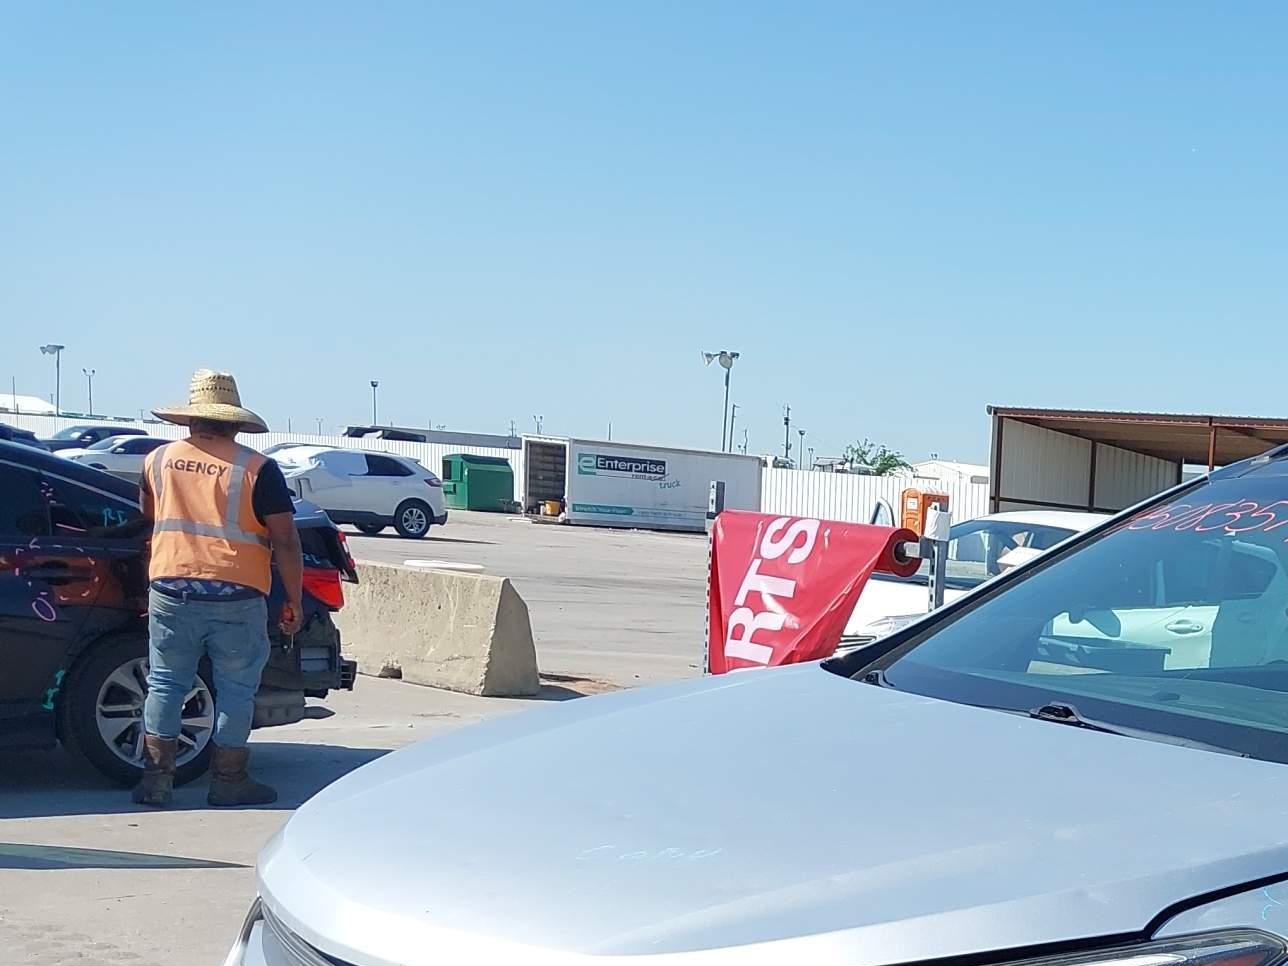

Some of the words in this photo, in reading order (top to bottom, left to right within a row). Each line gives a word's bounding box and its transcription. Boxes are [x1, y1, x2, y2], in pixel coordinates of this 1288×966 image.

[164, 458, 228, 477] AGENCY
[597, 457, 665, 473] Enterprise
[724, 517, 820, 665] RTS
